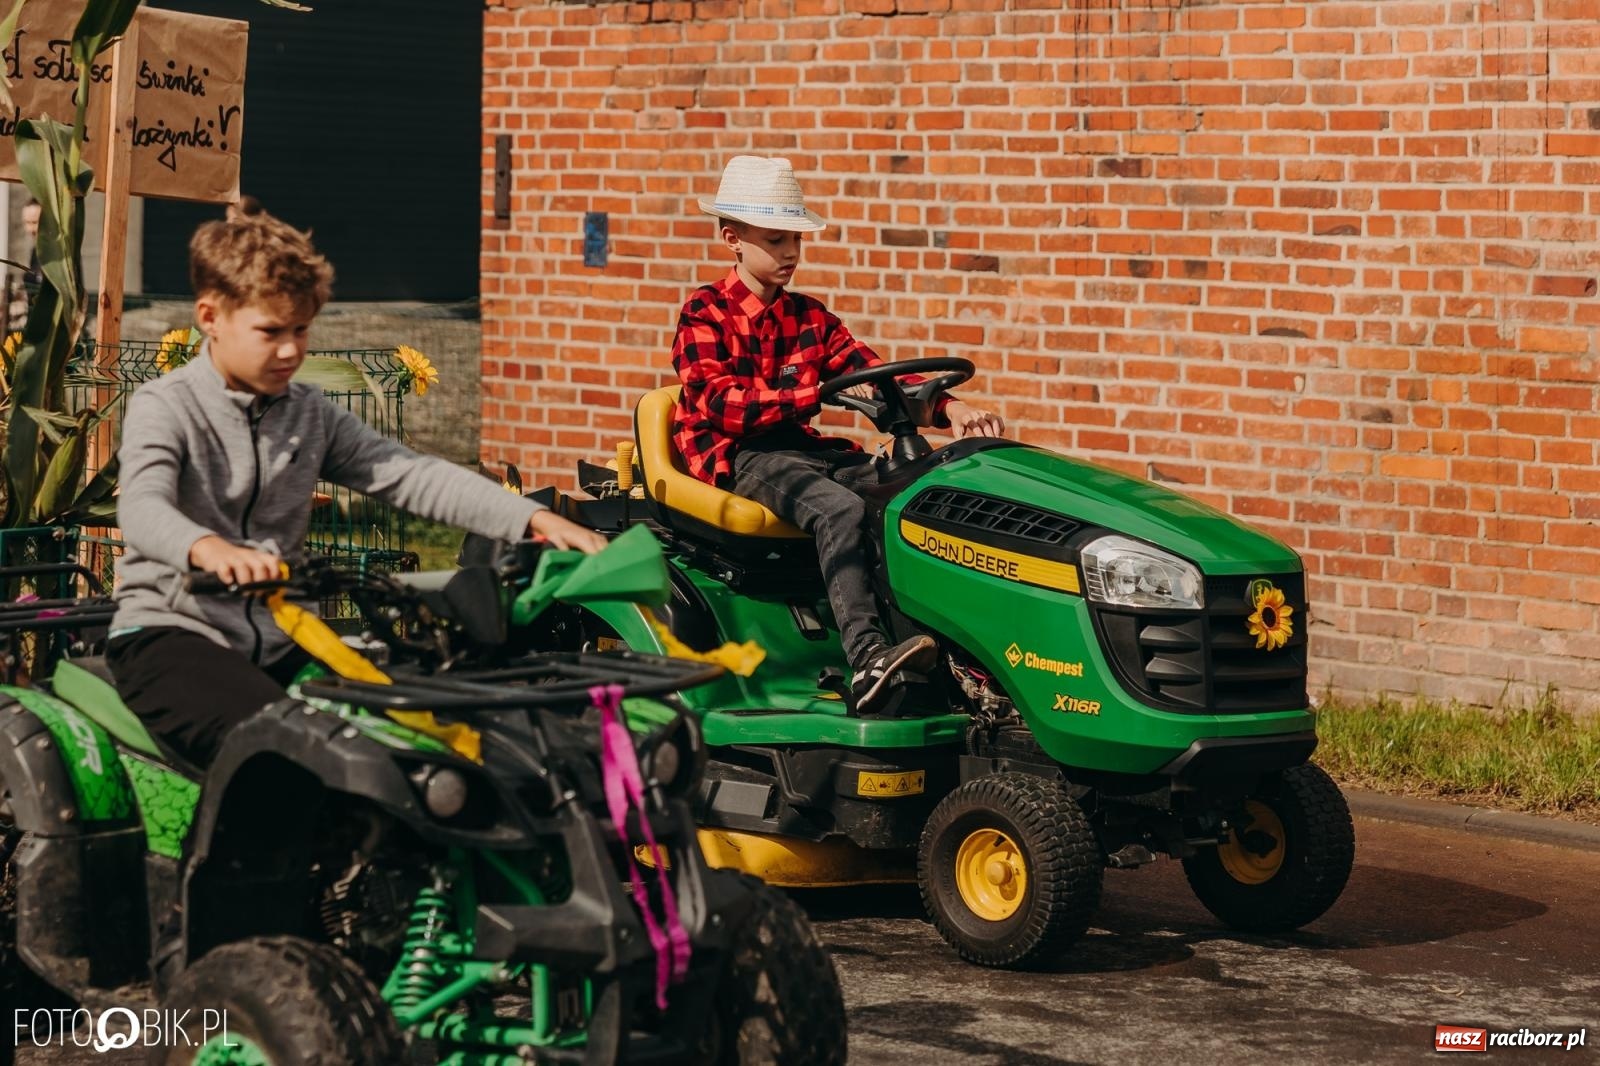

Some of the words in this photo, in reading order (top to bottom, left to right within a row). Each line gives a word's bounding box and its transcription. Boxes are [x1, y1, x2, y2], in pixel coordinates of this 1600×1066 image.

[919, 530, 959, 561] JOHN
[962, 545, 1019, 578] DEERE
[1024, 652, 1083, 677] Chempest
[1051, 692, 1101, 716] X116R
